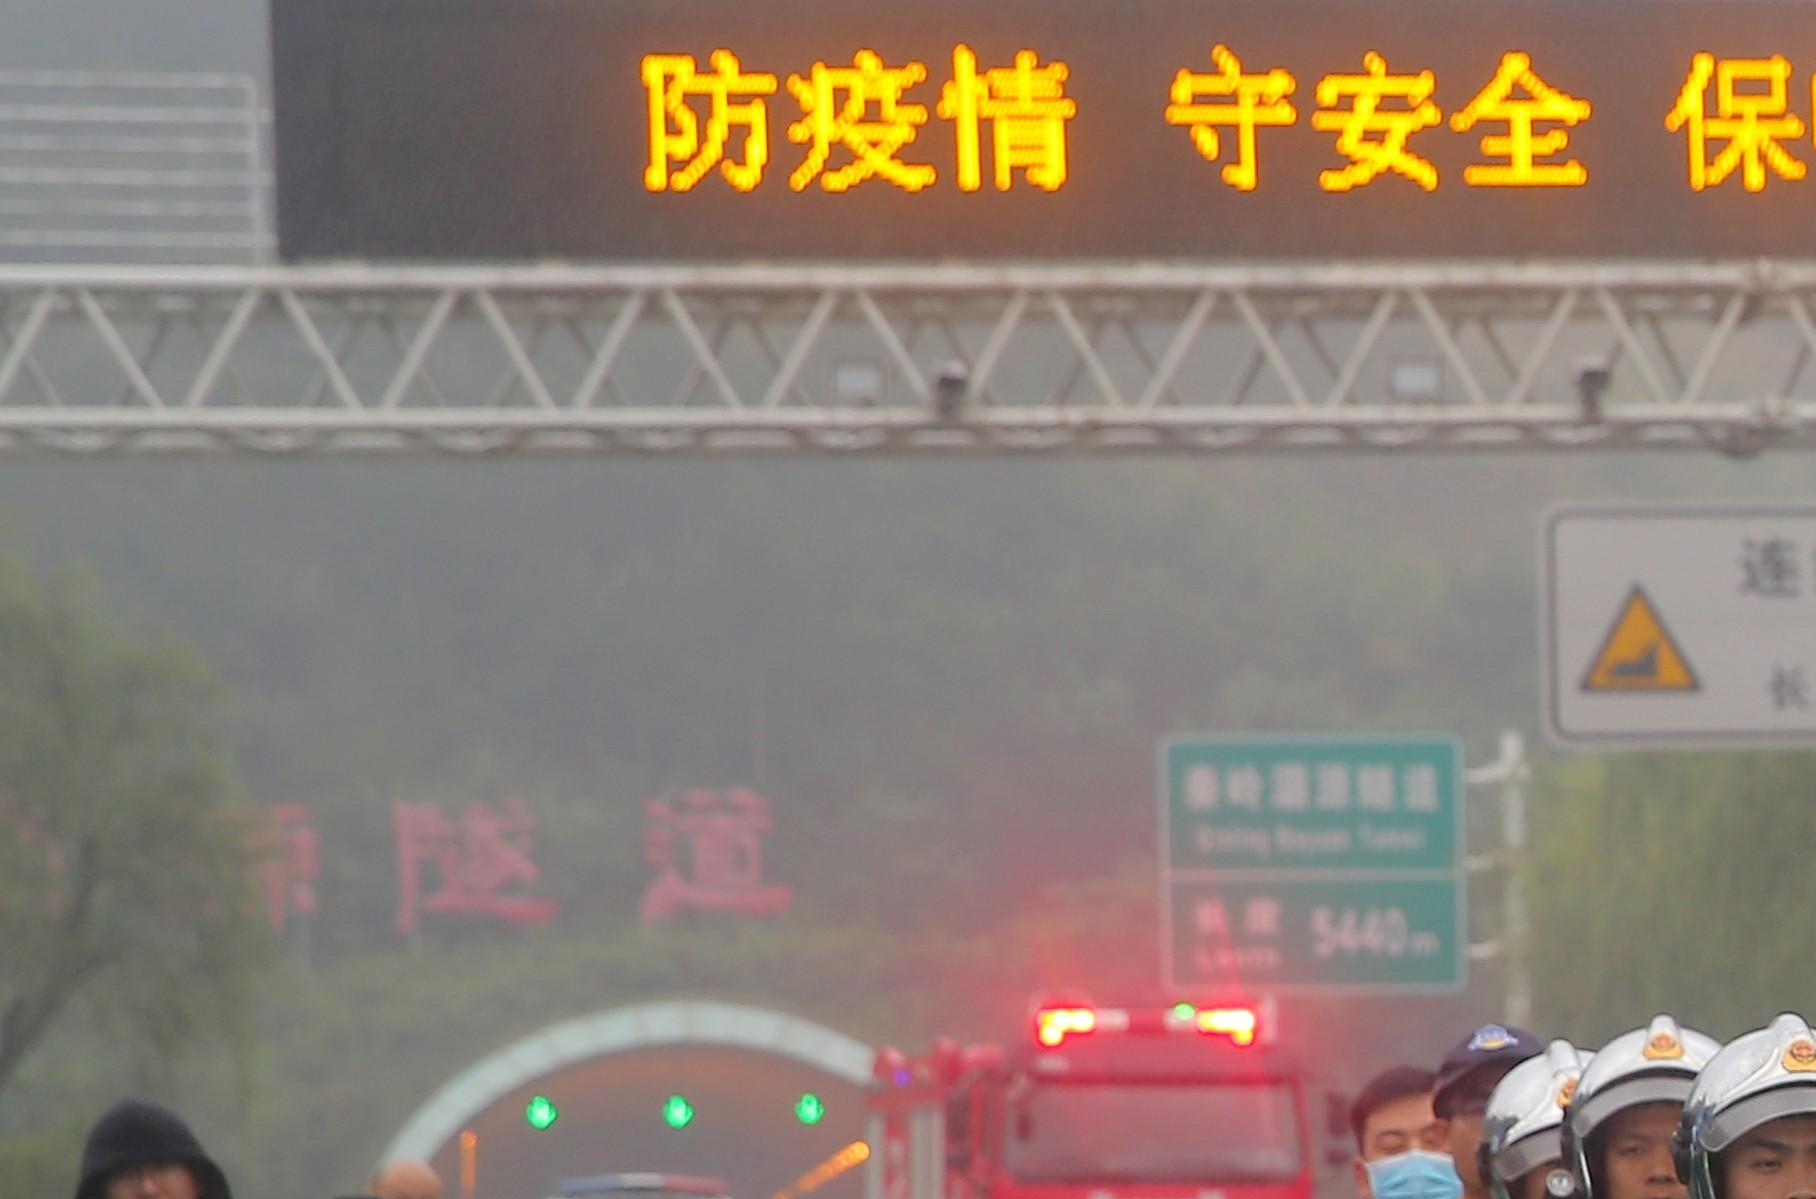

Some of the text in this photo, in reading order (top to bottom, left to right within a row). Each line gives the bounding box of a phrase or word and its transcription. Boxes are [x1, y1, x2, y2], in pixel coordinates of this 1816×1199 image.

[641, 44, 1076, 193] 防疫情
[1164, 44, 1593, 192] 守安全
